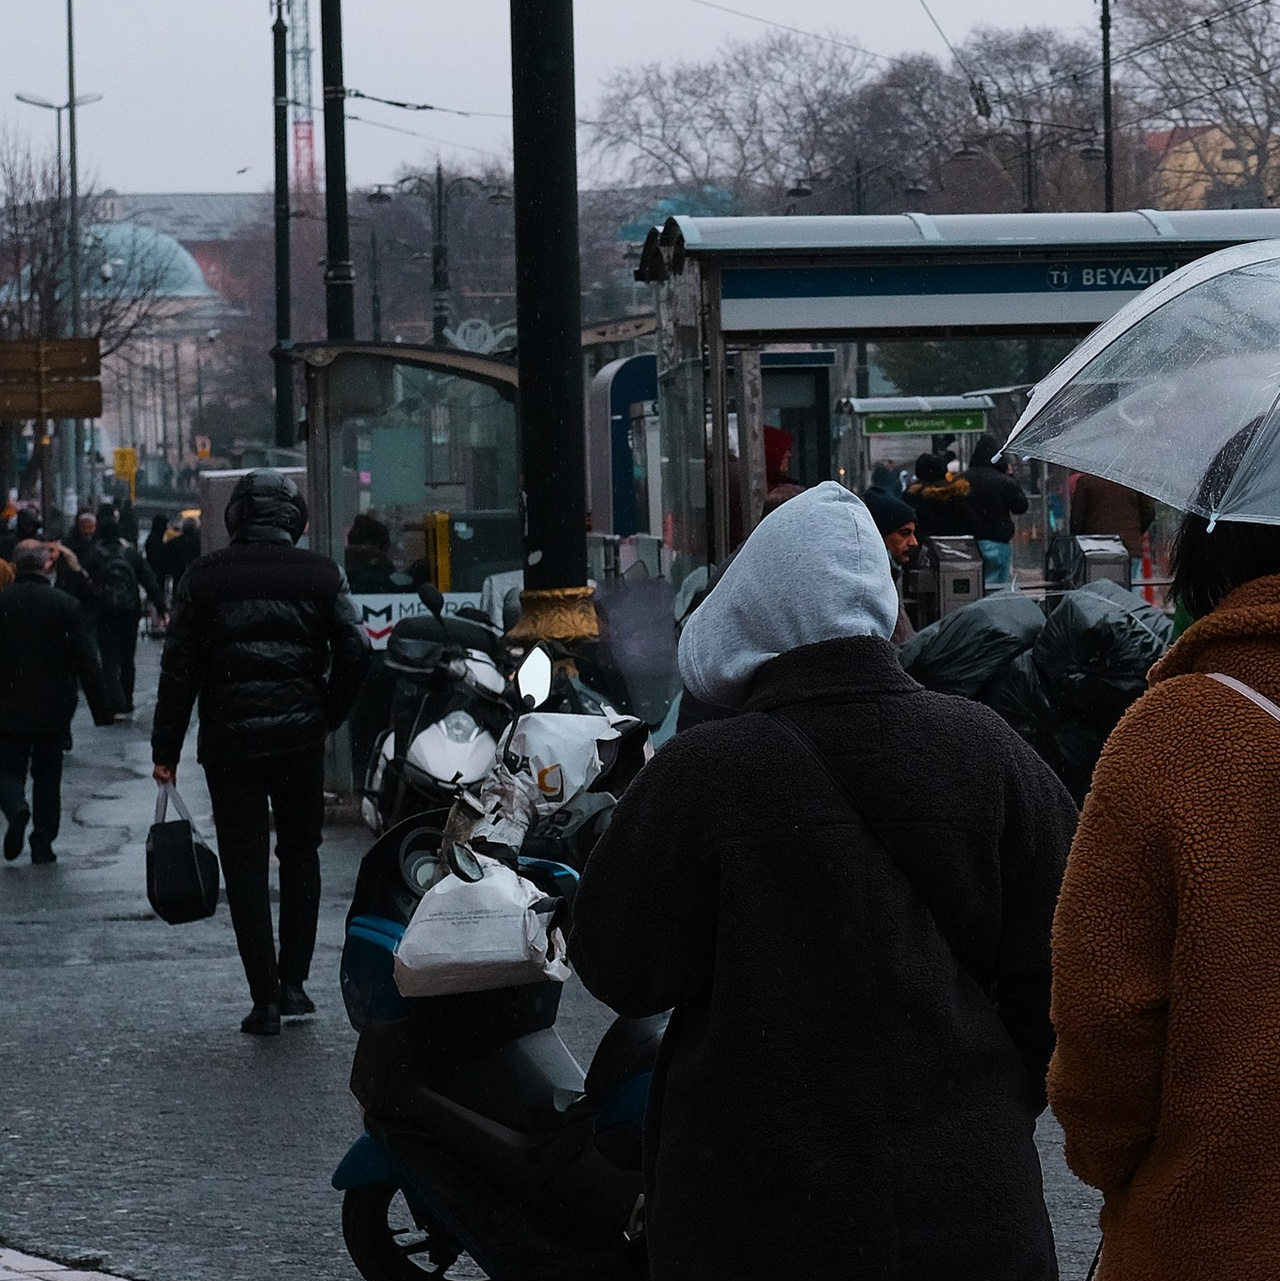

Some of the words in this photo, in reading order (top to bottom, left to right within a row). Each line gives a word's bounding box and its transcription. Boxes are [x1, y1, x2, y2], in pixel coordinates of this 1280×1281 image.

[1050, 271, 1069, 285] T1
[1082, 266, 1168, 285] BEYAZIT
[399, 601, 476, 618] MERO
